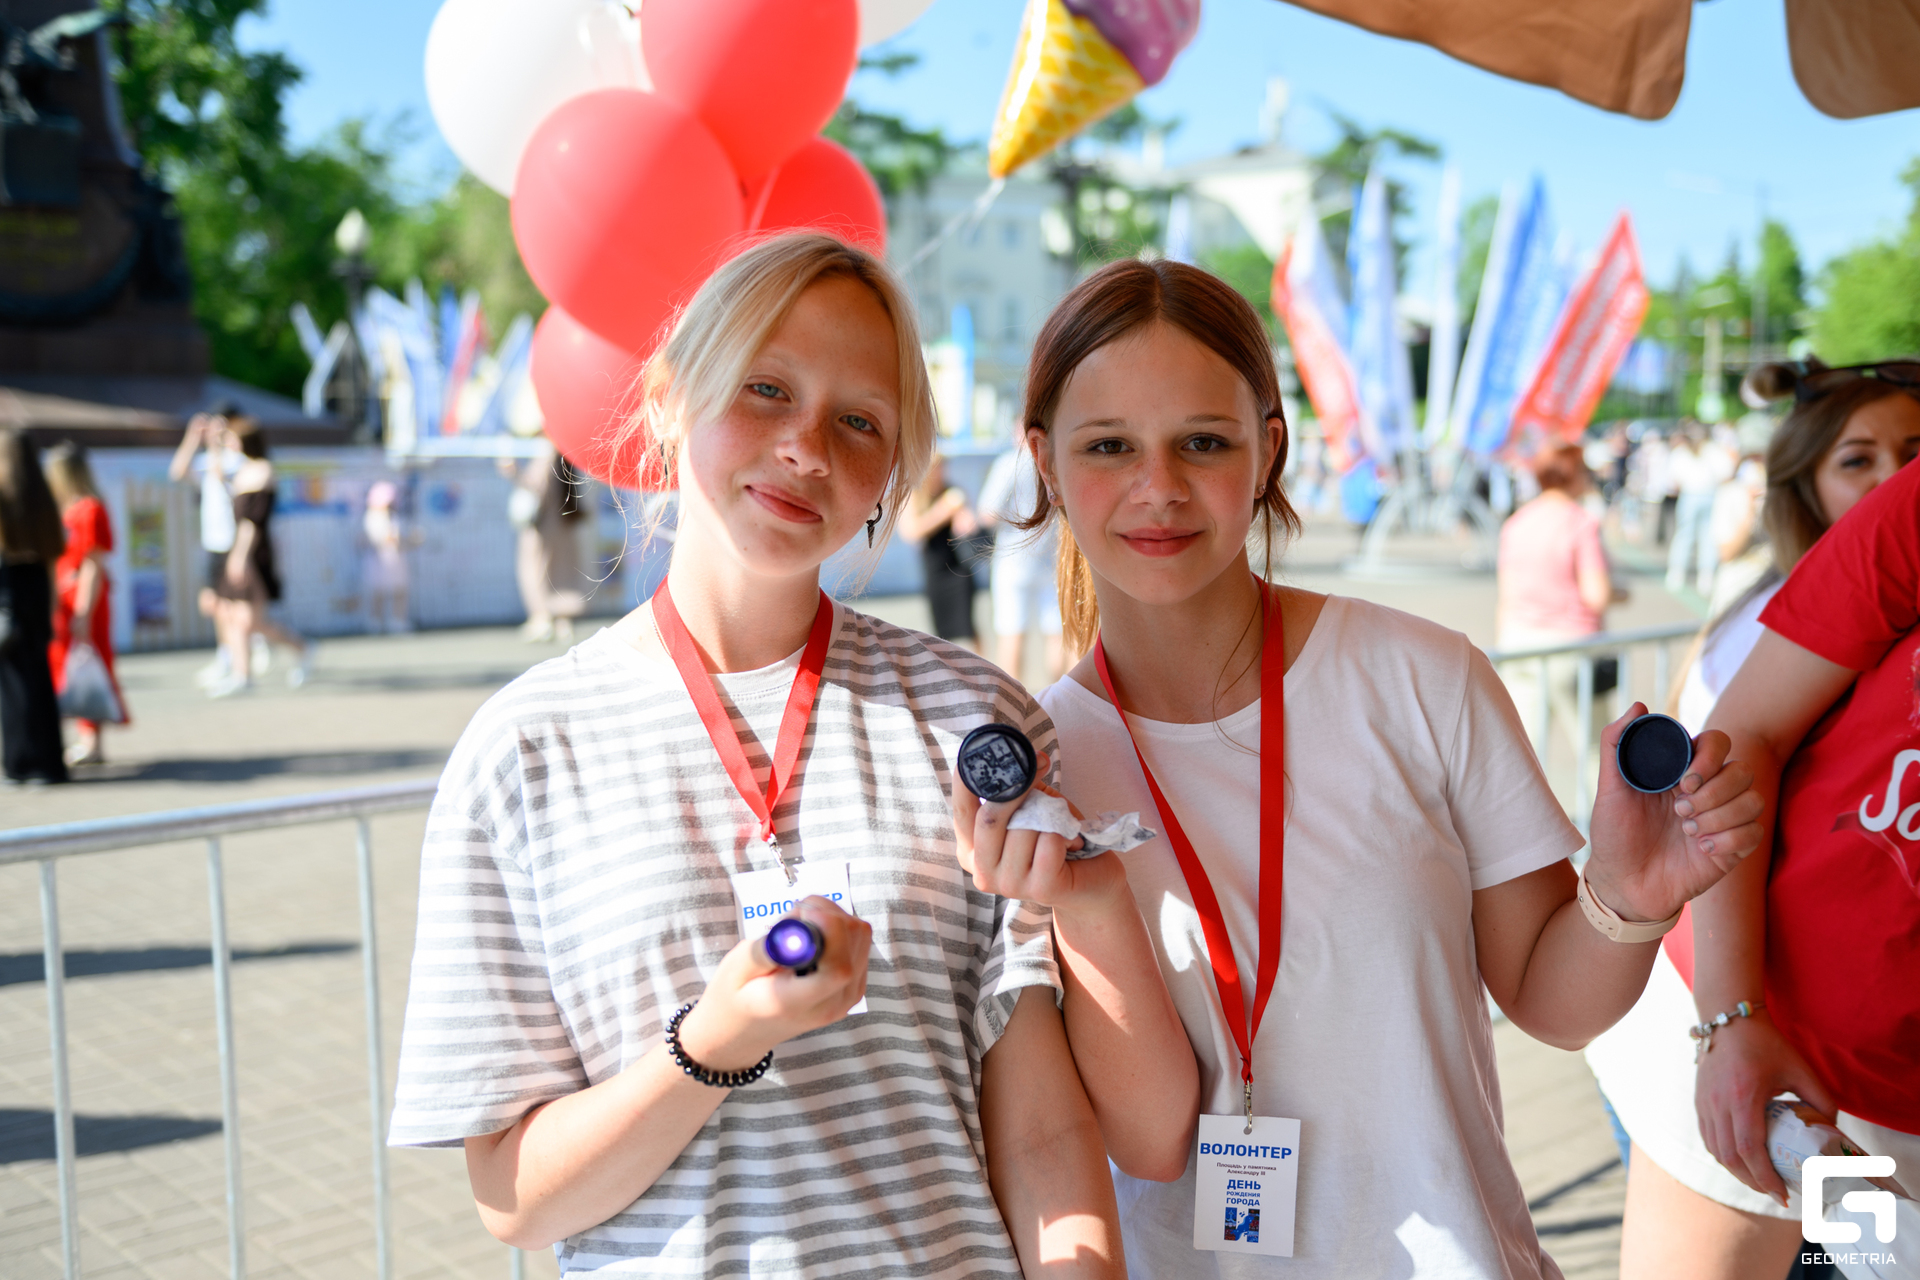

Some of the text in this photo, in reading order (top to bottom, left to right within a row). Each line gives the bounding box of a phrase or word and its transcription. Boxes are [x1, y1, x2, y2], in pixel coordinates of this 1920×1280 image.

[743, 892, 843, 920] ВОЛОР
[1199, 1142, 1292, 1159] ВОЛОНТЕР
[1227, 1168, 1260, 1176] Александру
[1226, 1179, 1262, 1190] ДЕНЬ
[1226, 1197, 1261, 1207] ГОРОДА
